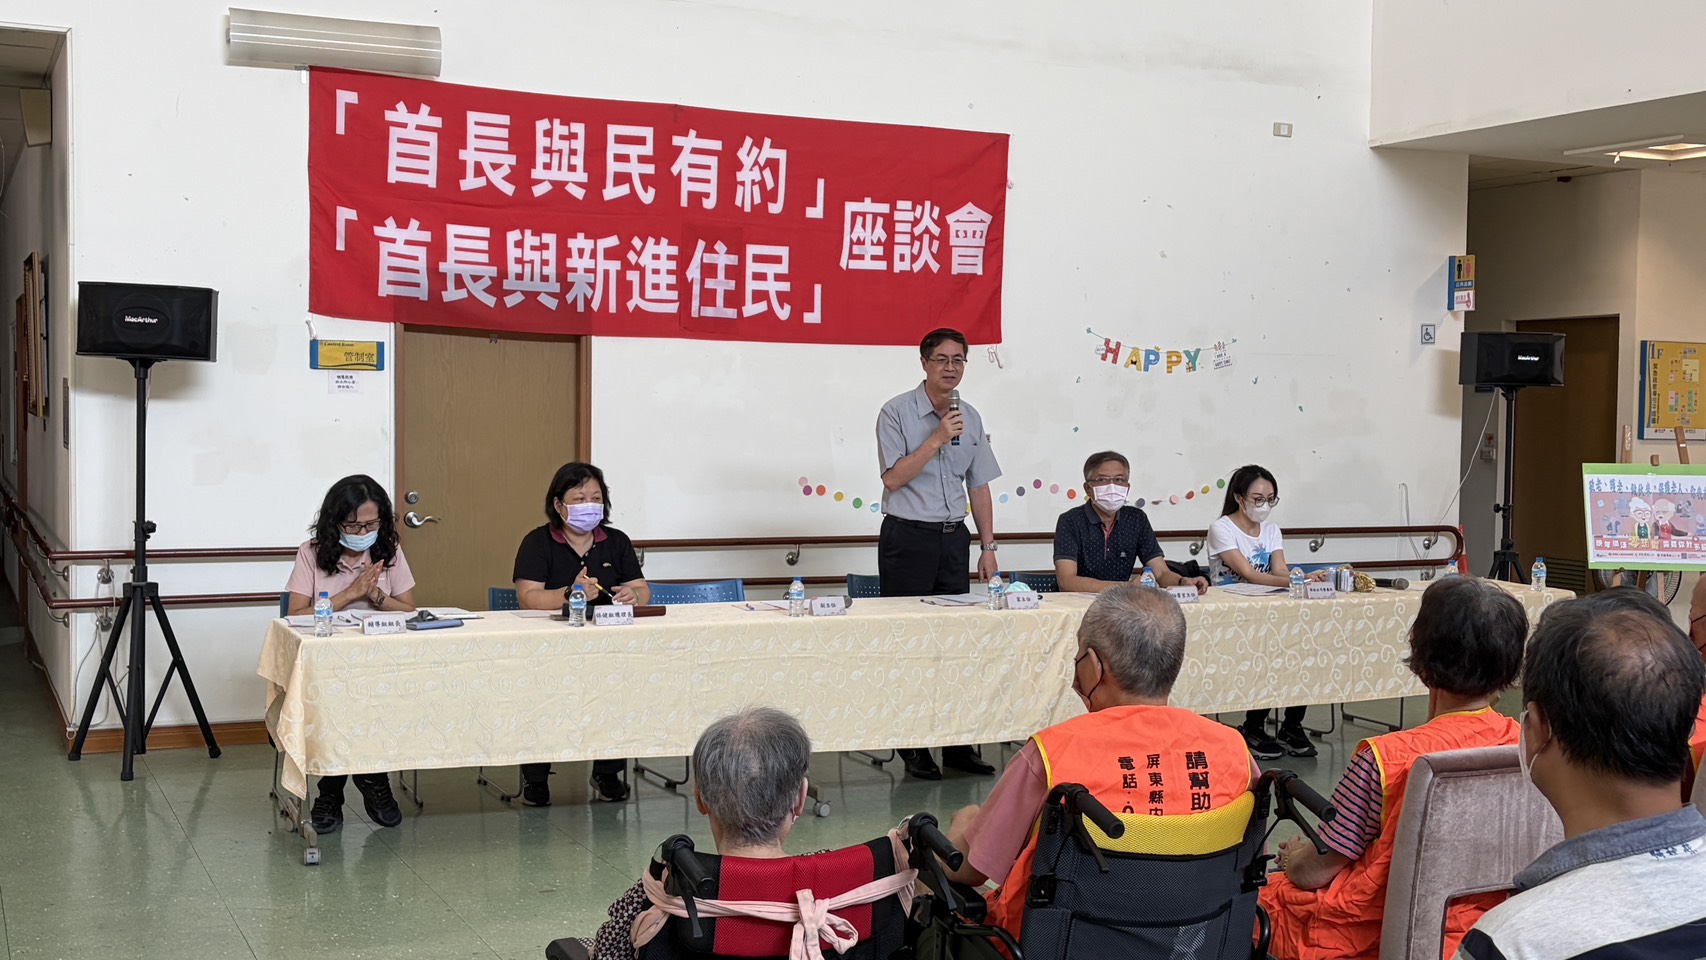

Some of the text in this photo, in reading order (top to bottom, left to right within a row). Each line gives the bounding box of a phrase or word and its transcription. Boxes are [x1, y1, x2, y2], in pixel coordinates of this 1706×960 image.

[336, 89, 825, 219] 「首長與民有約」
[336, 206, 822, 324] 「首長與新進住民」
[839, 198, 993, 276] 座談會
[124, 315, 158, 323] MacArthur
[344, 351, 375, 362] 管制室
[1101, 337, 1201, 374] HAPPY
[1185, 751, 1211, 811] 請幫助
